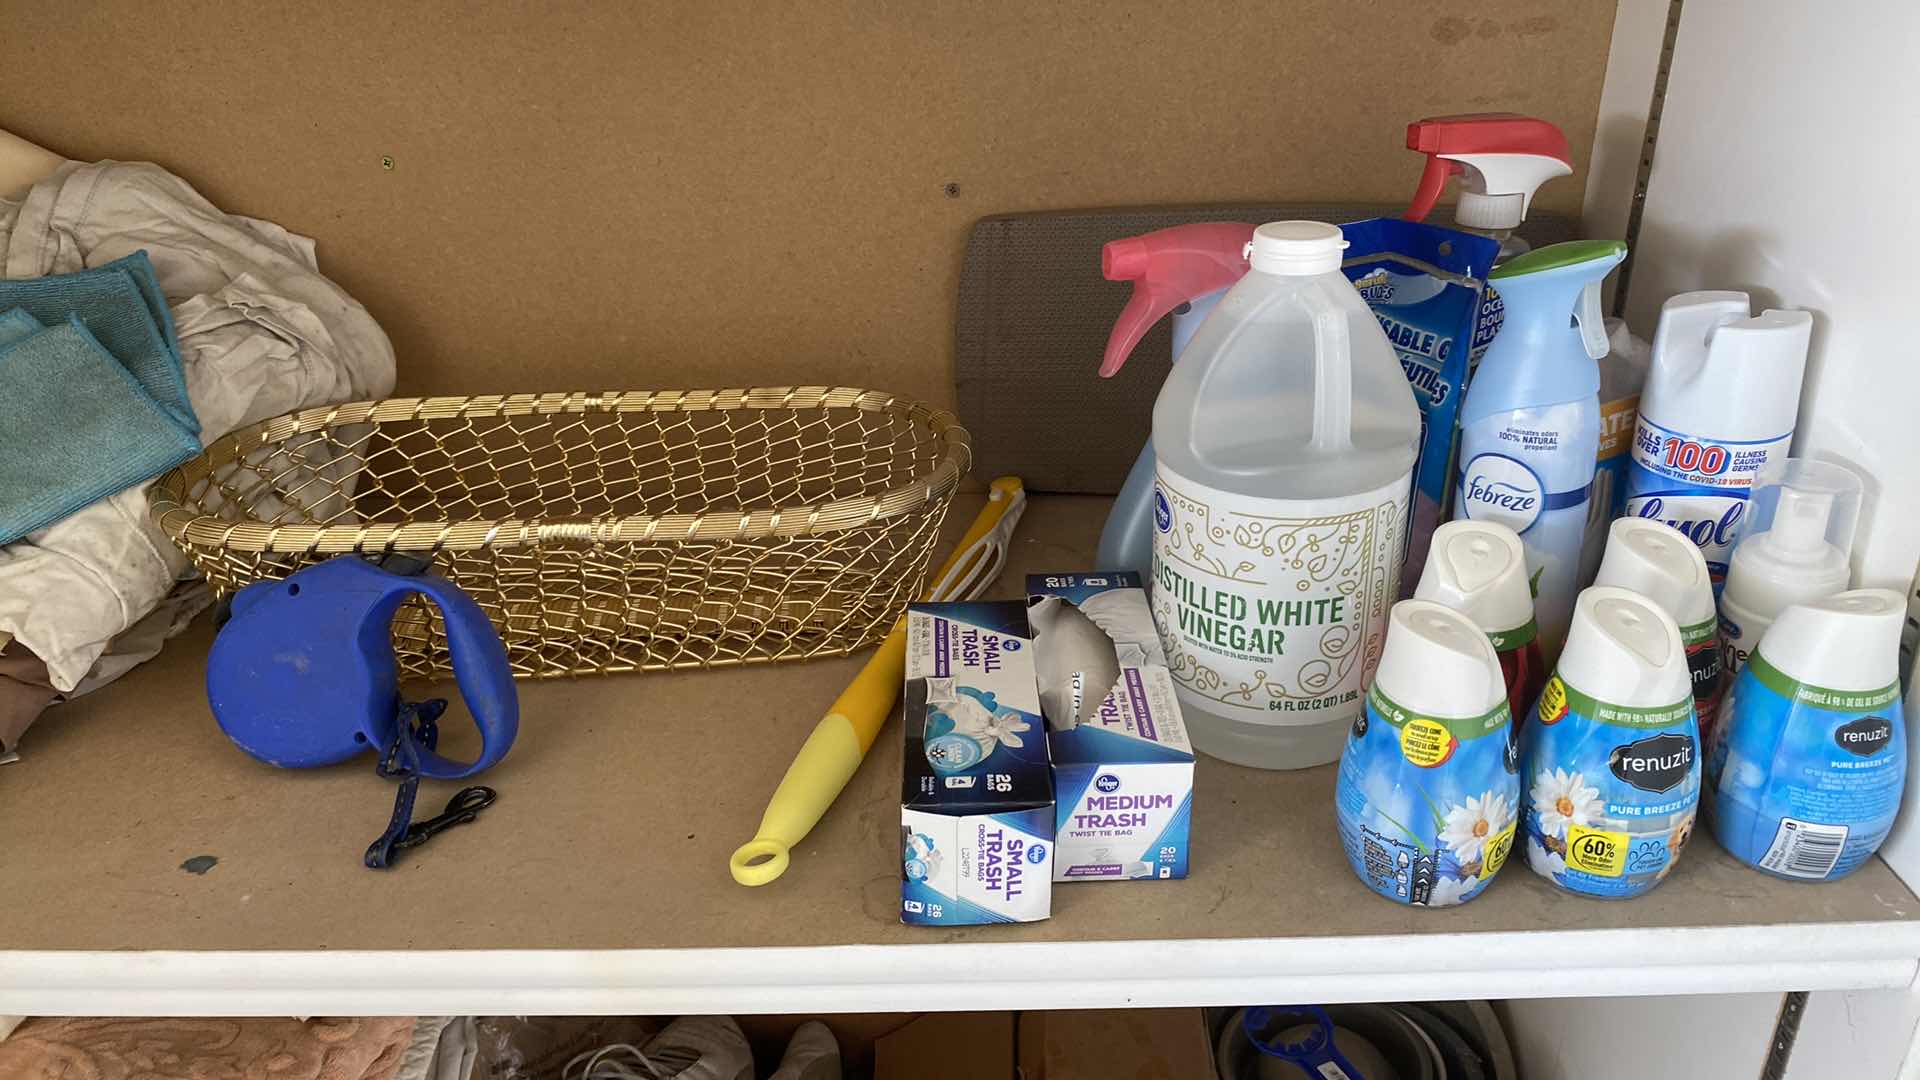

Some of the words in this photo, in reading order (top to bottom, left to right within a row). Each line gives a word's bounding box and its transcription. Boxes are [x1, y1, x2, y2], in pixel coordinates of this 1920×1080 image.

[1499, 431, 1520, 443] 100%
[1522, 436, 1558, 445] NATURAL
[1662, 437, 1728, 475] 100
[1733, 458, 1767, 466] CAUSING
[1734, 450, 1768, 459] ILLNESS
[1640, 458, 1672, 476] INCLUDING
[1673, 470, 1688, 481] THE
[1729, 478, 1753, 486] VIRUS
[1467, 475, 1535, 511] febreze
[1153, 552, 1248, 622] DISTILLED
[1256, 596, 1345, 627] WHITE
[951, 624, 960, 647] CROSS-TIE
[1177, 603, 1286, 656] VINEGAR
[952, 647, 960, 661] BAGS
[962, 629, 979, 667] TRASH
[983, 635, 1001, 674] SMALL
[1269, 700, 1282, 711] 64
[1284, 701, 1296, 711] FL
[1299, 700, 1310, 711] OZ
[1311, 698, 1321, 710] (2
[1323, 695, 1338, 708] QT)
[1843, 726, 1889, 743] renuzit
[1622, 746, 1691, 773] renuzit
[1831, 760, 1853, 769] PURE
[986, 773, 995, 791] BAGS
[995, 774, 1012, 792] 26
[1087, 794, 1173, 811] MEDIUM
[1609, 805, 1641, 817] PURE
[1643, 800, 1681, 816] BREEZE
[1074, 813, 1147, 829] TRASH
[977, 824, 986, 861] CROSS-TIE
[1069, 830, 1096, 838] TWIST
[1159, 846, 1176, 855] 20
[1583, 838, 1616, 859] 60%
[985, 829, 1003, 890] TRASH
[1582, 853, 1597, 863] More
[977, 862, 985, 882] BAGS
[1006, 839, 1024, 901] SMALL
[932, 903, 942, 918] 26
